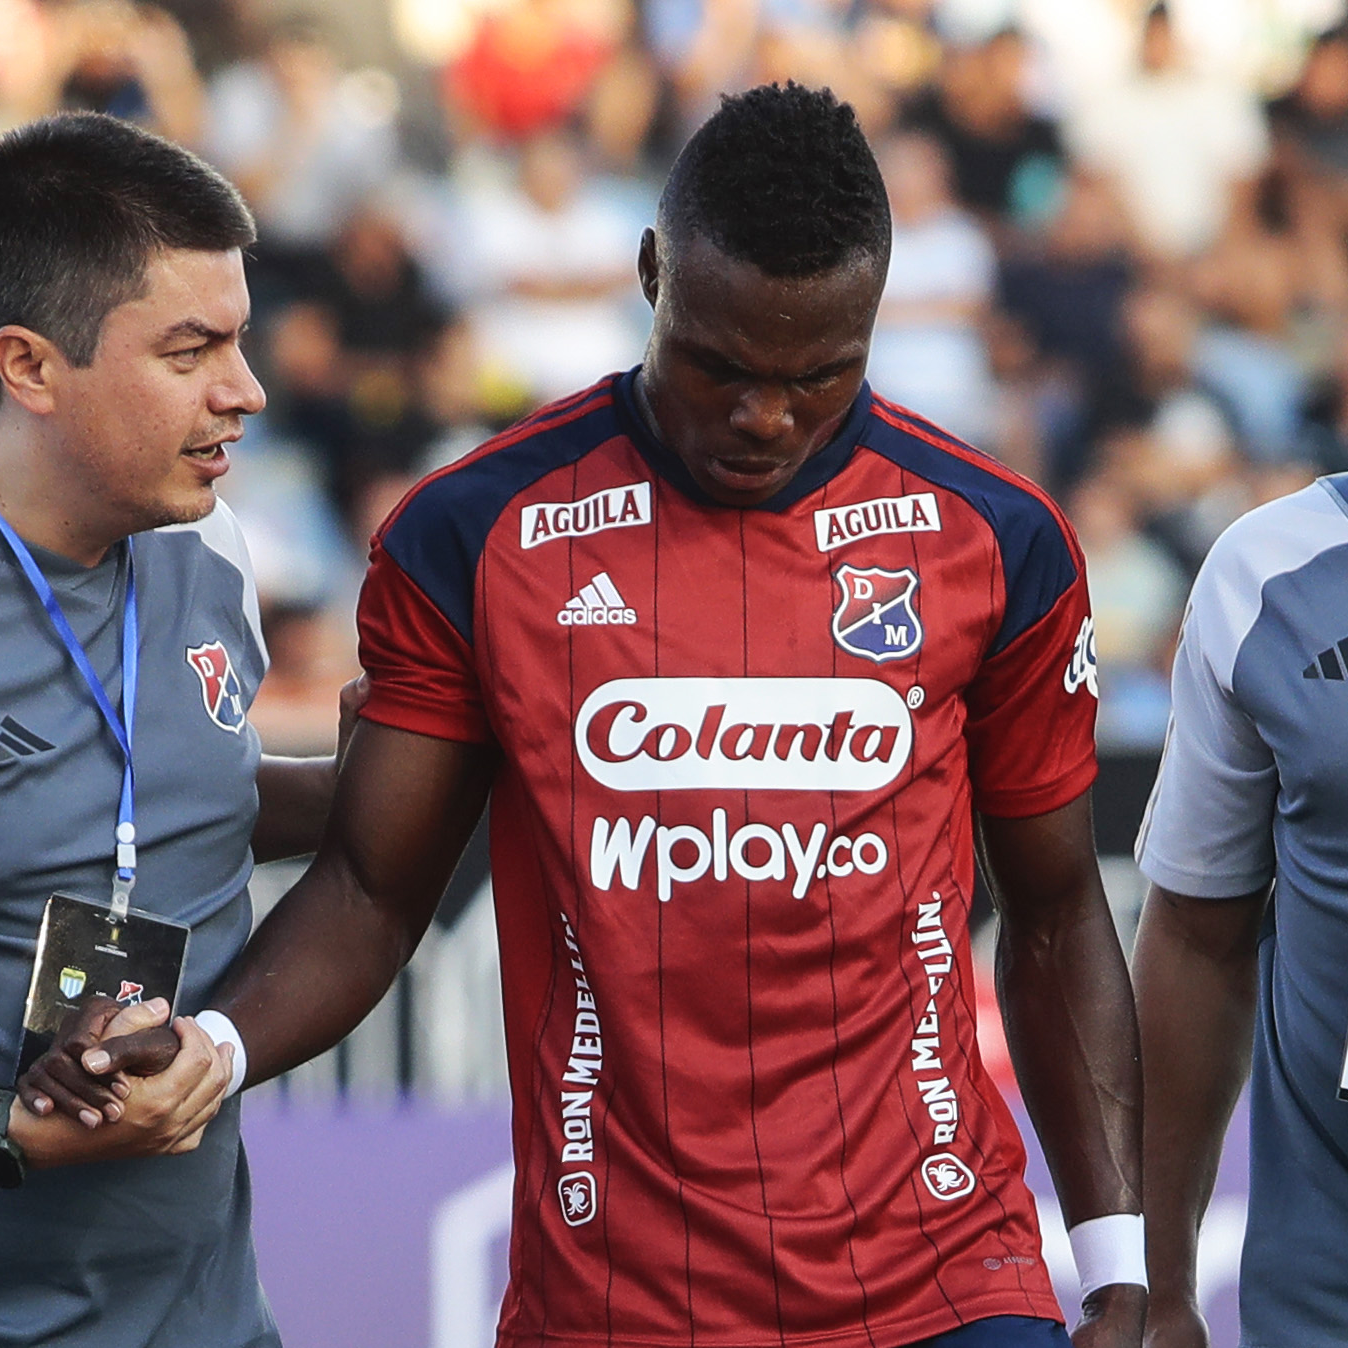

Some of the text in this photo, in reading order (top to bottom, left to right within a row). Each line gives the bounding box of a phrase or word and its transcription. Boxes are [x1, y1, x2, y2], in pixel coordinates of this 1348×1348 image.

[530, 489, 642, 542] AGUILA
[824, 498, 931, 546] AGUILA
[557, 604, 637, 626] adidas
[586, 700, 900, 763] Colanta
[590, 807, 889, 902] Wplay.co
[561, 1090, 593, 1163] RON
[916, 1076, 959, 1146] RON
